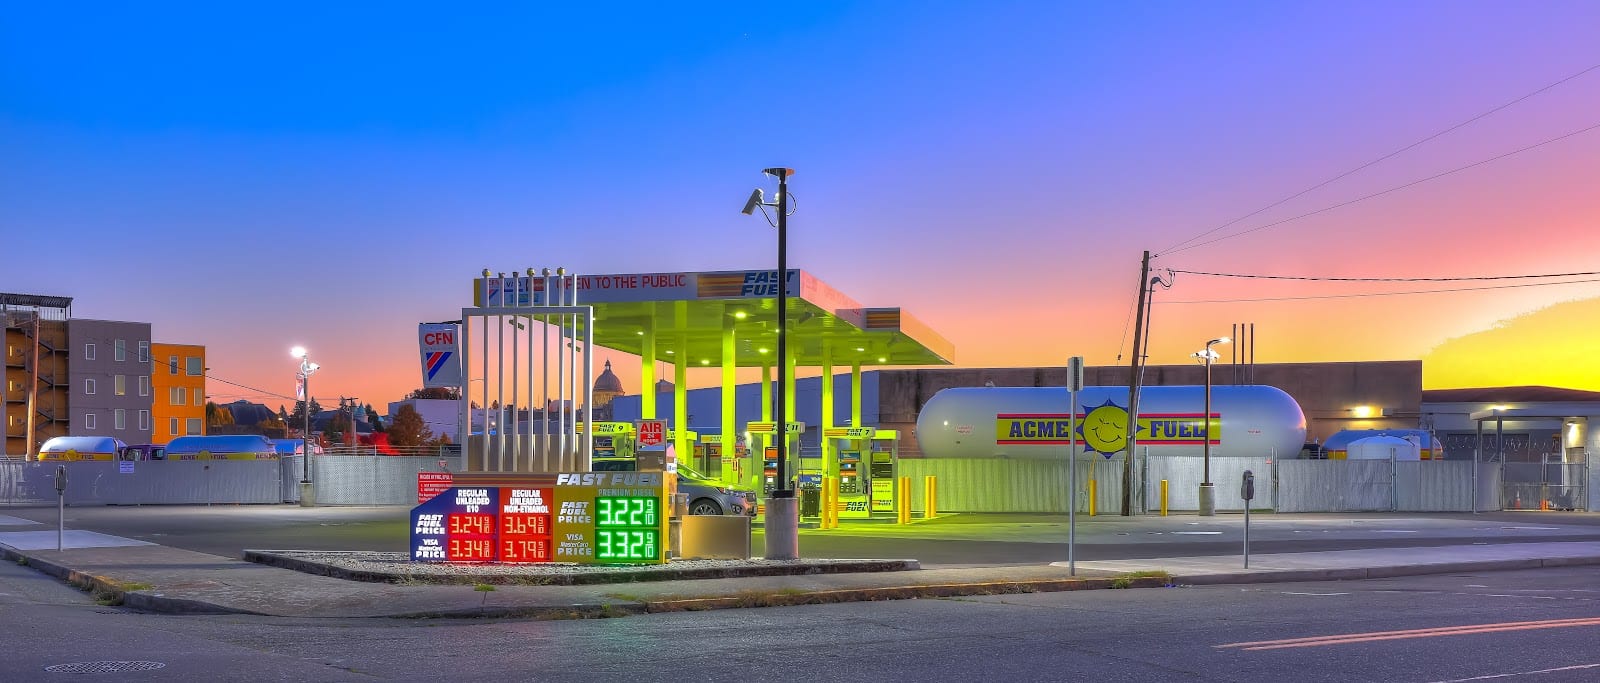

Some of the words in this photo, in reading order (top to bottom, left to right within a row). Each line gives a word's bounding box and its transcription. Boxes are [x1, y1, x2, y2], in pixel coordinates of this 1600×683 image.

[596, 276, 610, 288] TO
[614, 276, 637, 288] THE
[642, 274, 686, 288] PUBLIC
[744, 271, 795, 283] FAST
[741, 284, 790, 296] FUE
[424, 332, 453, 345] CFN
[640, 422, 662, 432] AIR
[1009, 421, 1069, 437] ACME
[1150, 420, 1207, 437] FUEL
[556, 474, 606, 486] FAST
[611, 474, 660, 486] FUEL
[599, 500, 644, 524] 3.22
[452, 517, 482, 534] 3.24
[505, 517, 536, 534] 3.69
[452, 541, 482, 558] 3.34
[505, 541, 536, 558] 3.79
[599, 532, 644, 557] 3.32
